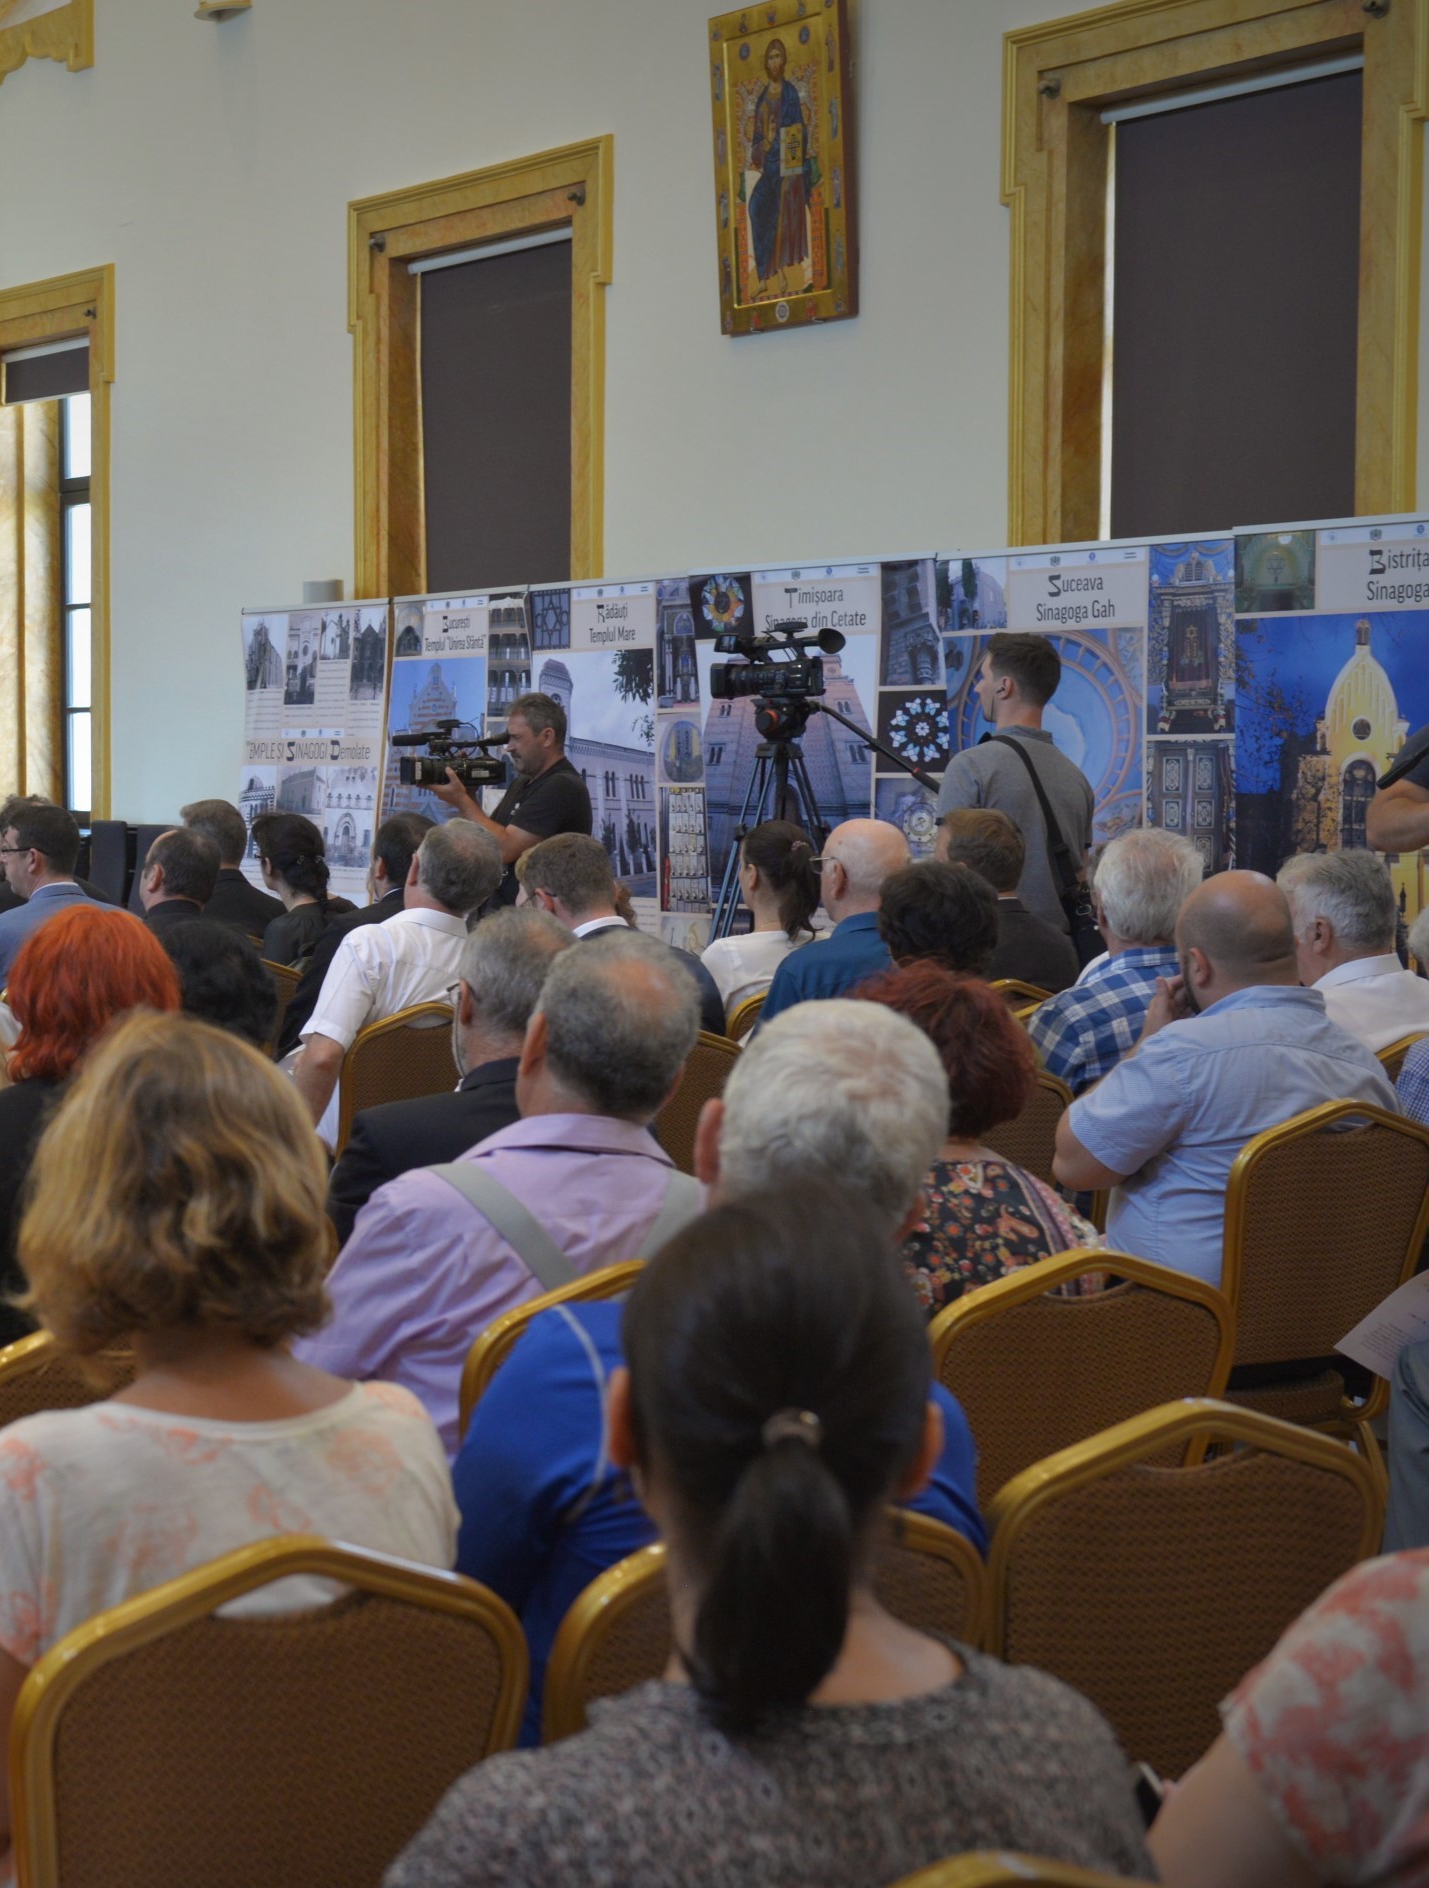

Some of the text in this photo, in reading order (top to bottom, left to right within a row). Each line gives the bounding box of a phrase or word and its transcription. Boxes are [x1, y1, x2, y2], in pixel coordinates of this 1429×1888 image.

[1368, 547, 1429, 575] Bistrița
[1047, 573, 1104, 598] Suceava
[1366, 580, 1429, 604] Sinagoga
[784, 586, 844, 609] Timișoara
[596, 602, 628, 623] Rădăuți
[811, 611, 828, 629] din
[830, 609, 867, 628] Cetate
[1036, 598, 1116, 624] Sinagoga Gah
[589, 625, 636, 646] Templul Mare
[286, 741, 328, 761] SINAGOGI
[330, 739, 371, 760] Demolate
